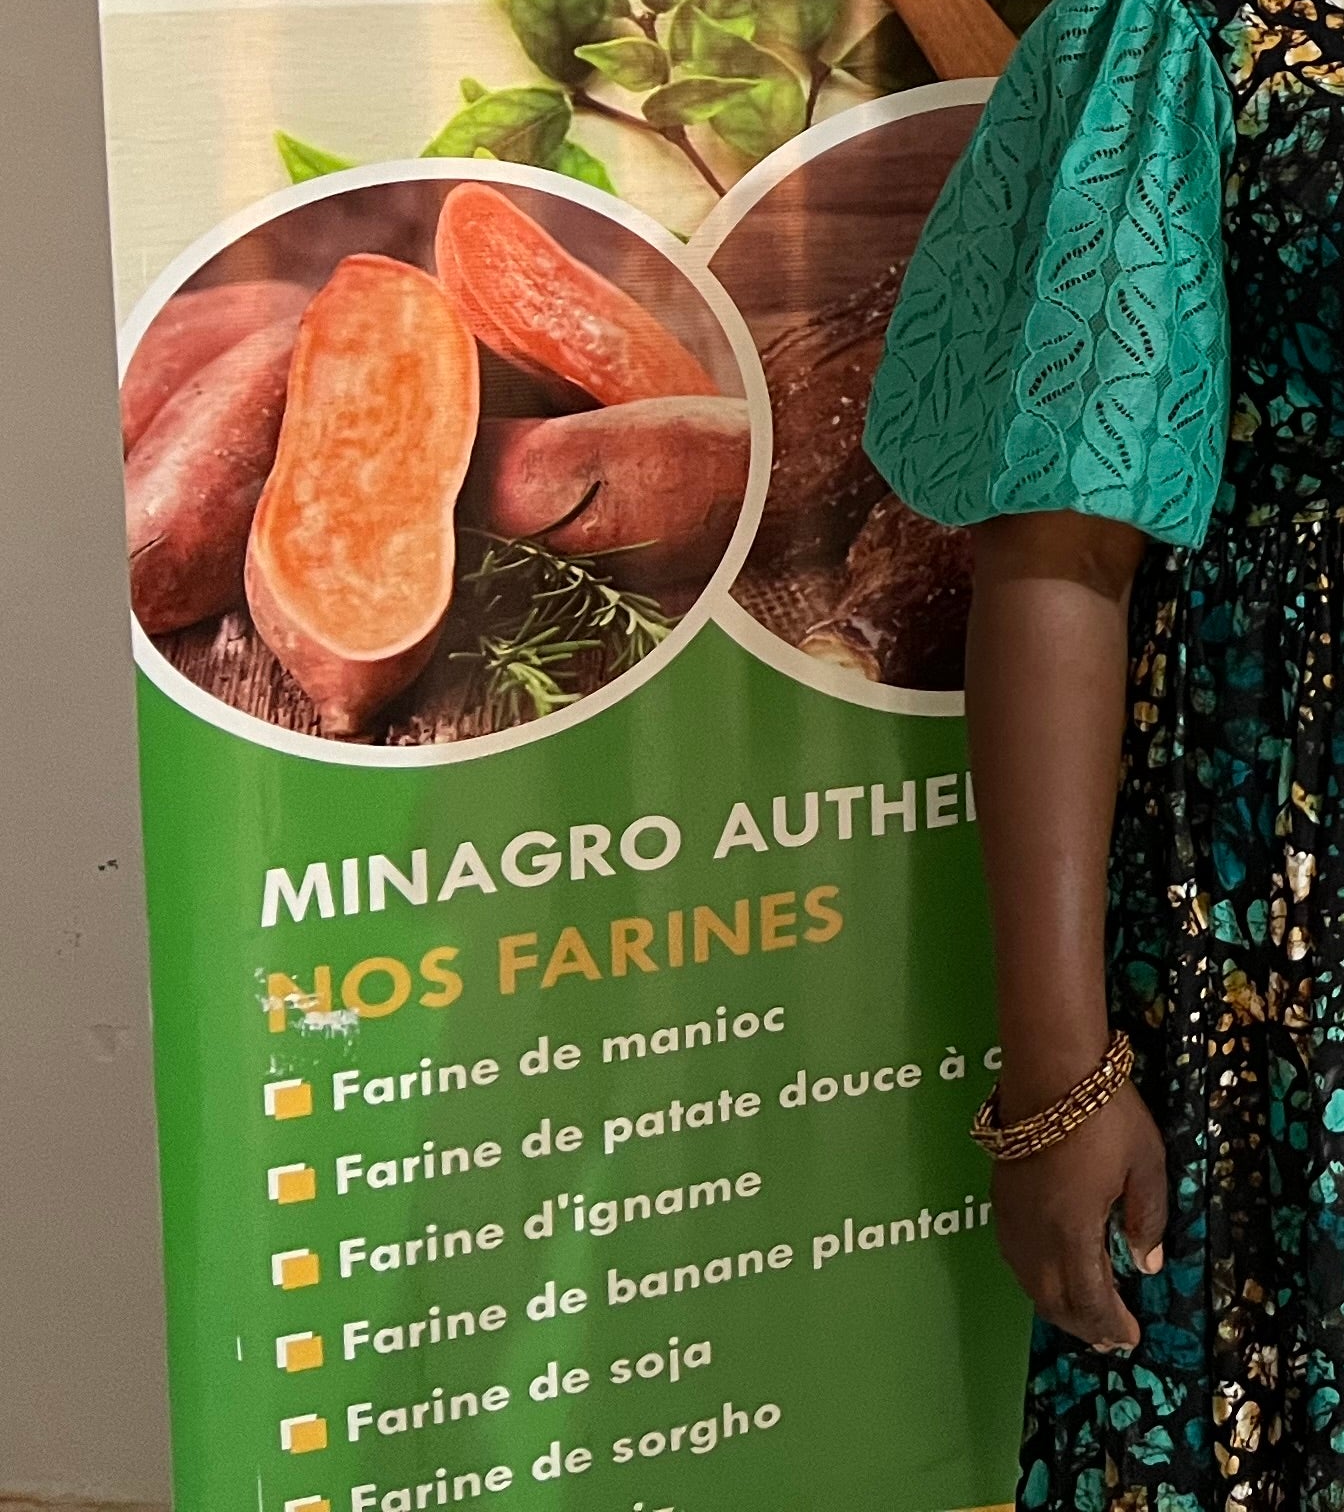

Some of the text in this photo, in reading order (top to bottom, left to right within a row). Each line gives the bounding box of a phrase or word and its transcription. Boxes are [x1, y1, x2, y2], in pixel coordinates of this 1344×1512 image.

[260, 814, 682, 928] MINAGRO
[265, 884, 845, 1034] NOS FARINES
[331, 1004, 786, 1112] Farine de manioc
[334, 1140, 502, 1196] Farine
[520, 1119, 584, 1161] de
[603, 1085, 761, 1155] patate
[778, 1061, 922, 1111] douce
[938, 1045, 966, 1081] à
[338, 1168, 762, 1279] Farine d'igname
[341, 1304, 507, 1361] Farine
[525, 1282, 588, 1322] de
[606, 1242, 794, 1306] banane
[345, 1335, 712, 1443] Farine de soja
[350, 1401, 782, 1512] Farine de sorgho
